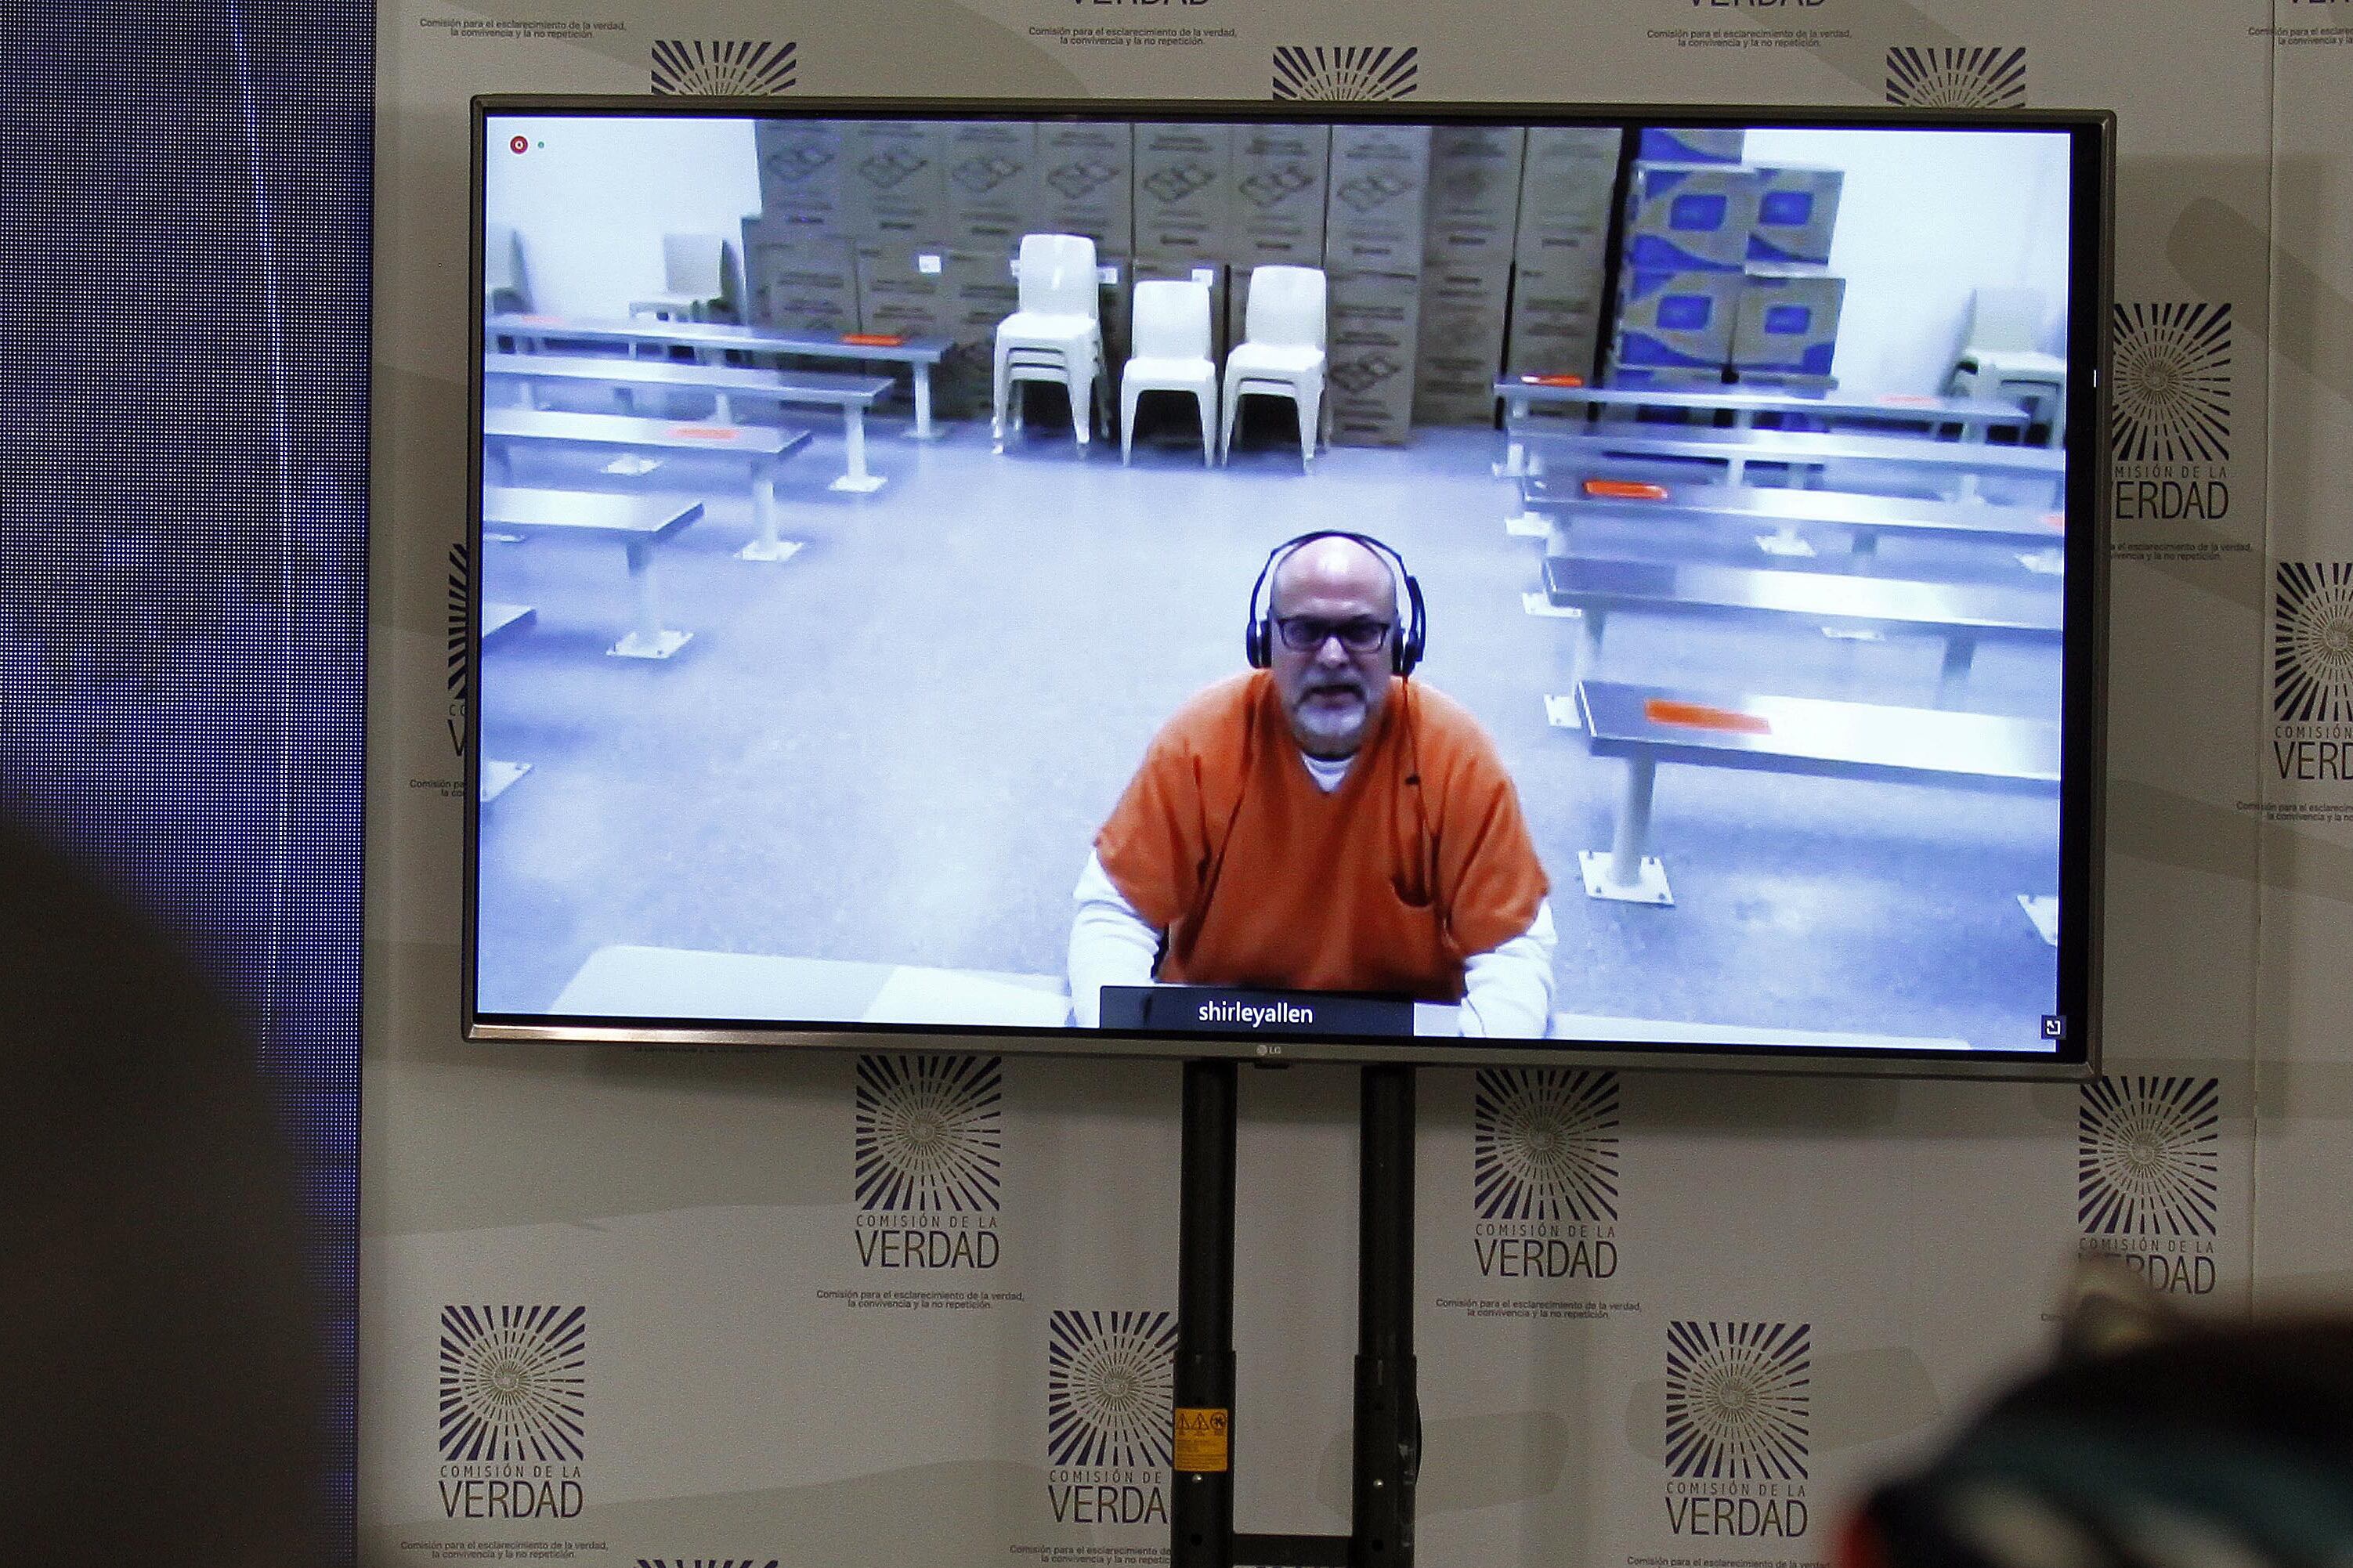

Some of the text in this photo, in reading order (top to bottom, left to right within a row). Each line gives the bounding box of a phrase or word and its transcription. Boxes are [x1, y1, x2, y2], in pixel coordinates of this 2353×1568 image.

[420, 19, 461, 27] Comisión
[464, 21, 483, 30] para
[486, 20, 493, 28] el
[497, 20, 566, 29] esclarecimiento
[583, 21, 591, 30] la
[1029, 27, 1071, 36] Comisión
[1073, 29, 1092, 38] para
[1106, 28, 1176, 37] esclarecimiento
[1178, 29, 1190, 38] de
[1193, 29, 1200, 38] la
[1647, 30, 1688, 38] Comisión
[1691, 31, 1709, 40] para
[1795, 31, 1805, 39] de
[1809, 31, 1816, 39] la
[2116, 464, 2227, 478] MISIÓN DE LA
[2116, 481, 2228, 519] ERDAD
[2275, 724, 2351, 739] COMISIÓN
[410, 779, 451, 788] Comisión
[1198, 1001, 1314, 1028] shirleyallen
[857, 1213, 996, 1228] COMISIÓN DE LA
[1476, 1223, 1614, 1237] COMISIÓN DE LA
[855, 1230, 999, 1268] VERDAD
[2079, 1237, 2214, 1253] COMISIÓN DE LA
[1474, 1239, 1617, 1278] VERDAD
[817, 1291, 858, 1299] Comisión
[861, 1292, 880, 1301] para
[894, 1292, 963, 1300] esclarecimiento
[965, 1292, 977, 1301] de
[980, 1292, 988, 1301] la
[1437, 1299, 1477, 1308] Comisión
[1480, 1301, 1498, 1310] para
[1598, 1302, 1606, 1310] la
[440, 1463, 580, 1478] COMISIÓN DE LA
[1050, 1469, 1161, 1483] COMISIÓN DE
[1666, 1479, 1805, 1497] COMISIÓN DE LA
[439, 1480, 584, 1518] VERDAD
[1048, 1486, 1168, 1523] VERDA
[1665, 1497, 1808, 1537] VERDAD
[401, 1542, 443, 1551] Comisión
[445, 1544, 464, 1552] para
[467, 1542, 475, 1551] el
[478, 1542, 547, 1551] esclarecimiento
[1009, 1545, 1171, 1555] Comisión para el esclarecimiento de
[1041, 1554, 1049, 1563] la
[1138, 1555, 1170, 1565] repetic
